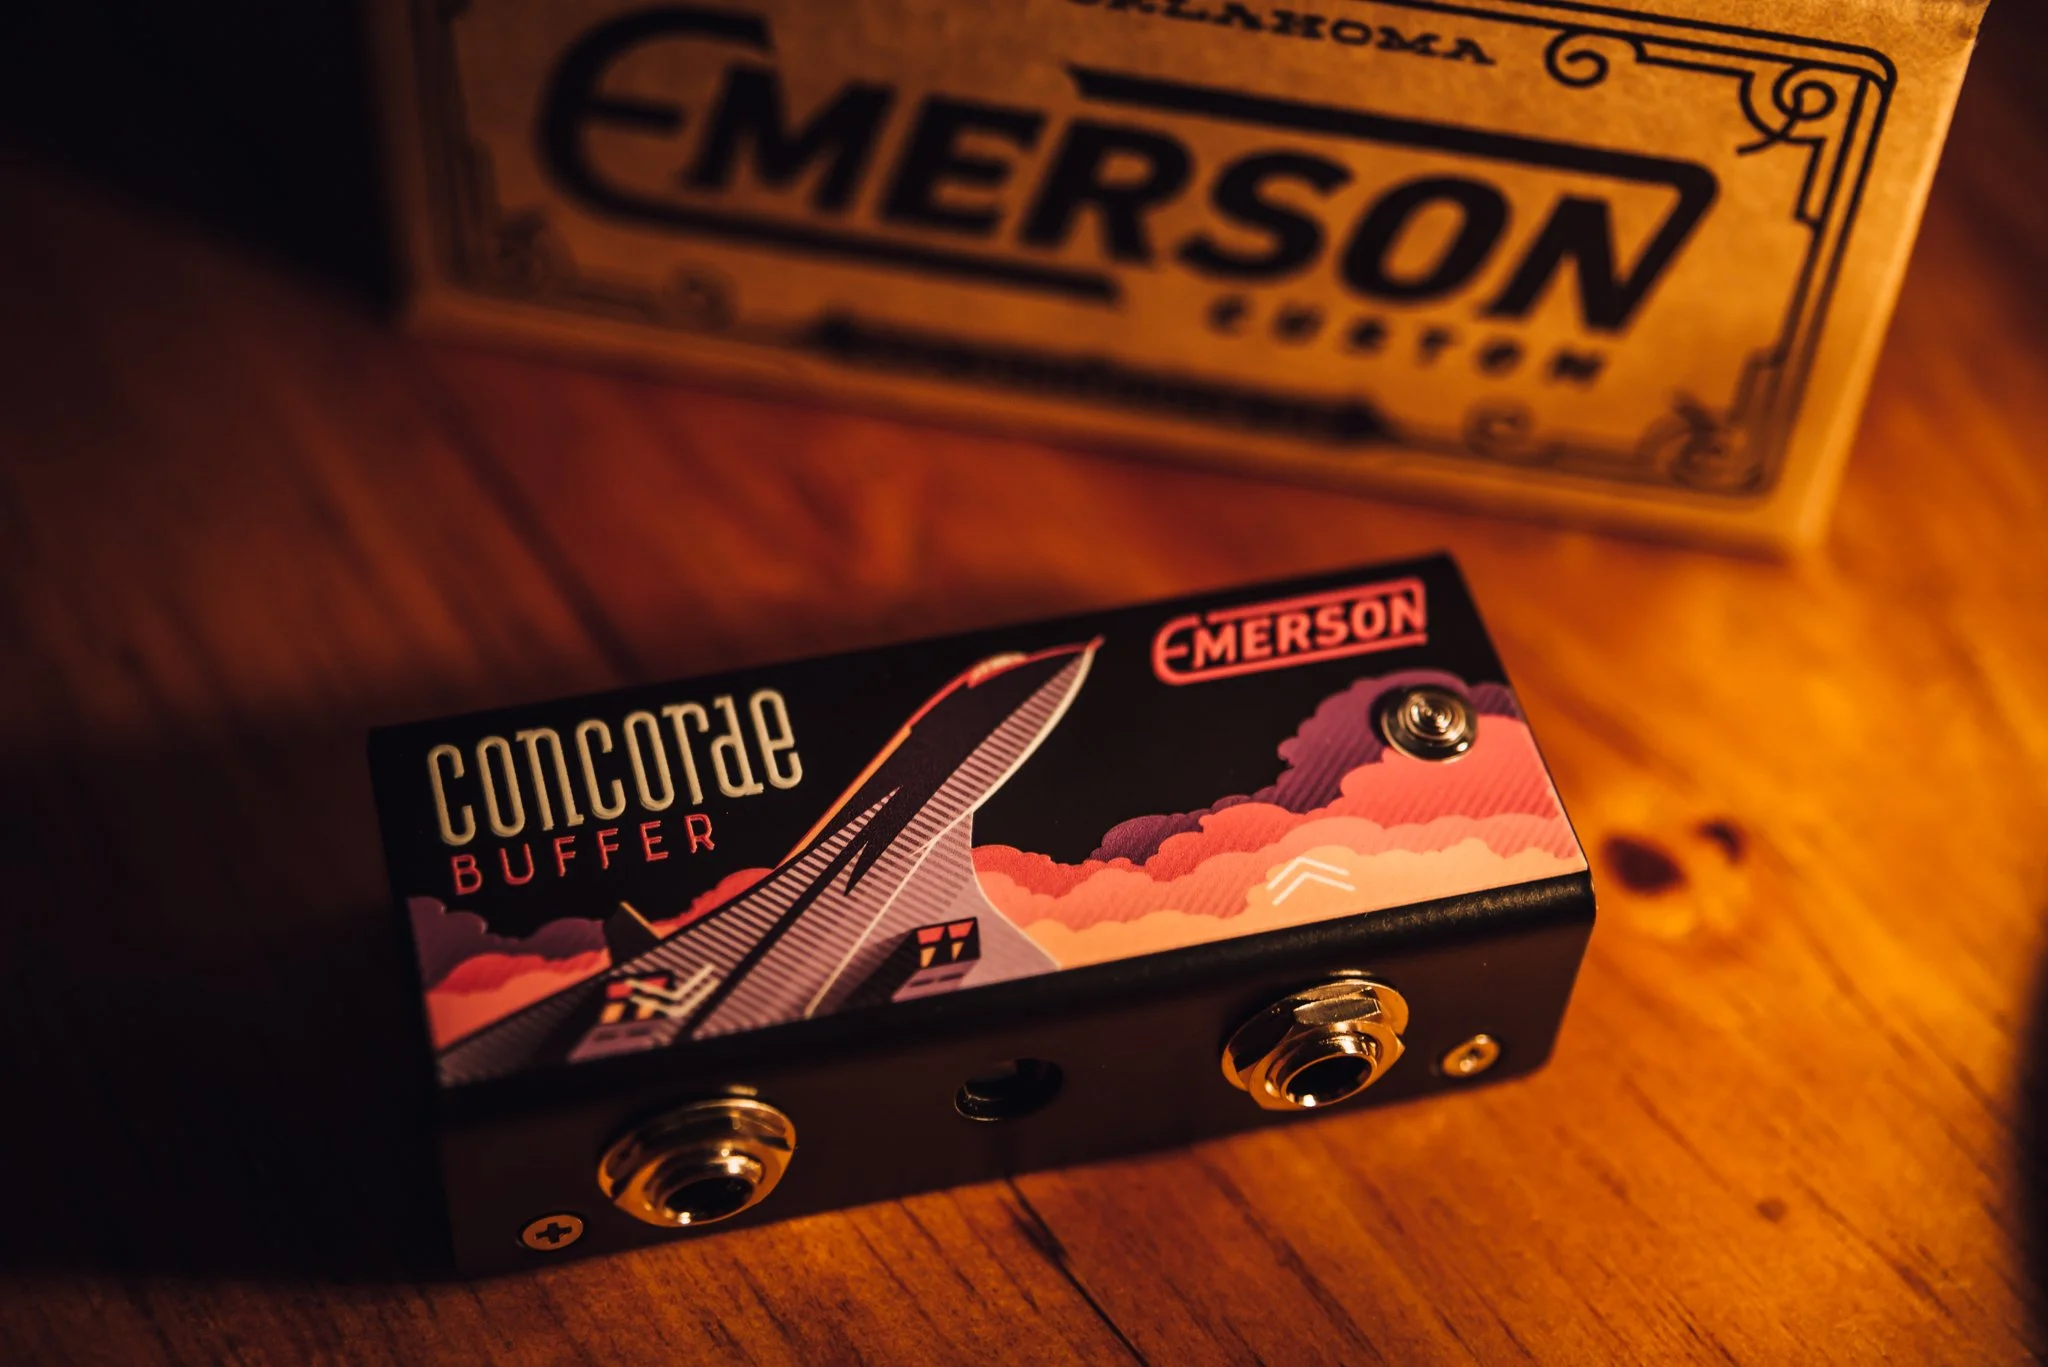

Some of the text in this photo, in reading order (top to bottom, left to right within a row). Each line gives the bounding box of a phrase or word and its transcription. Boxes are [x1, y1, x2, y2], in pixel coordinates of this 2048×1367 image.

[533, 6, 1720, 338] EMERSON
[1151, 575, 1429, 686] EMERSON
[450, 812, 716, 896] BUFFER
